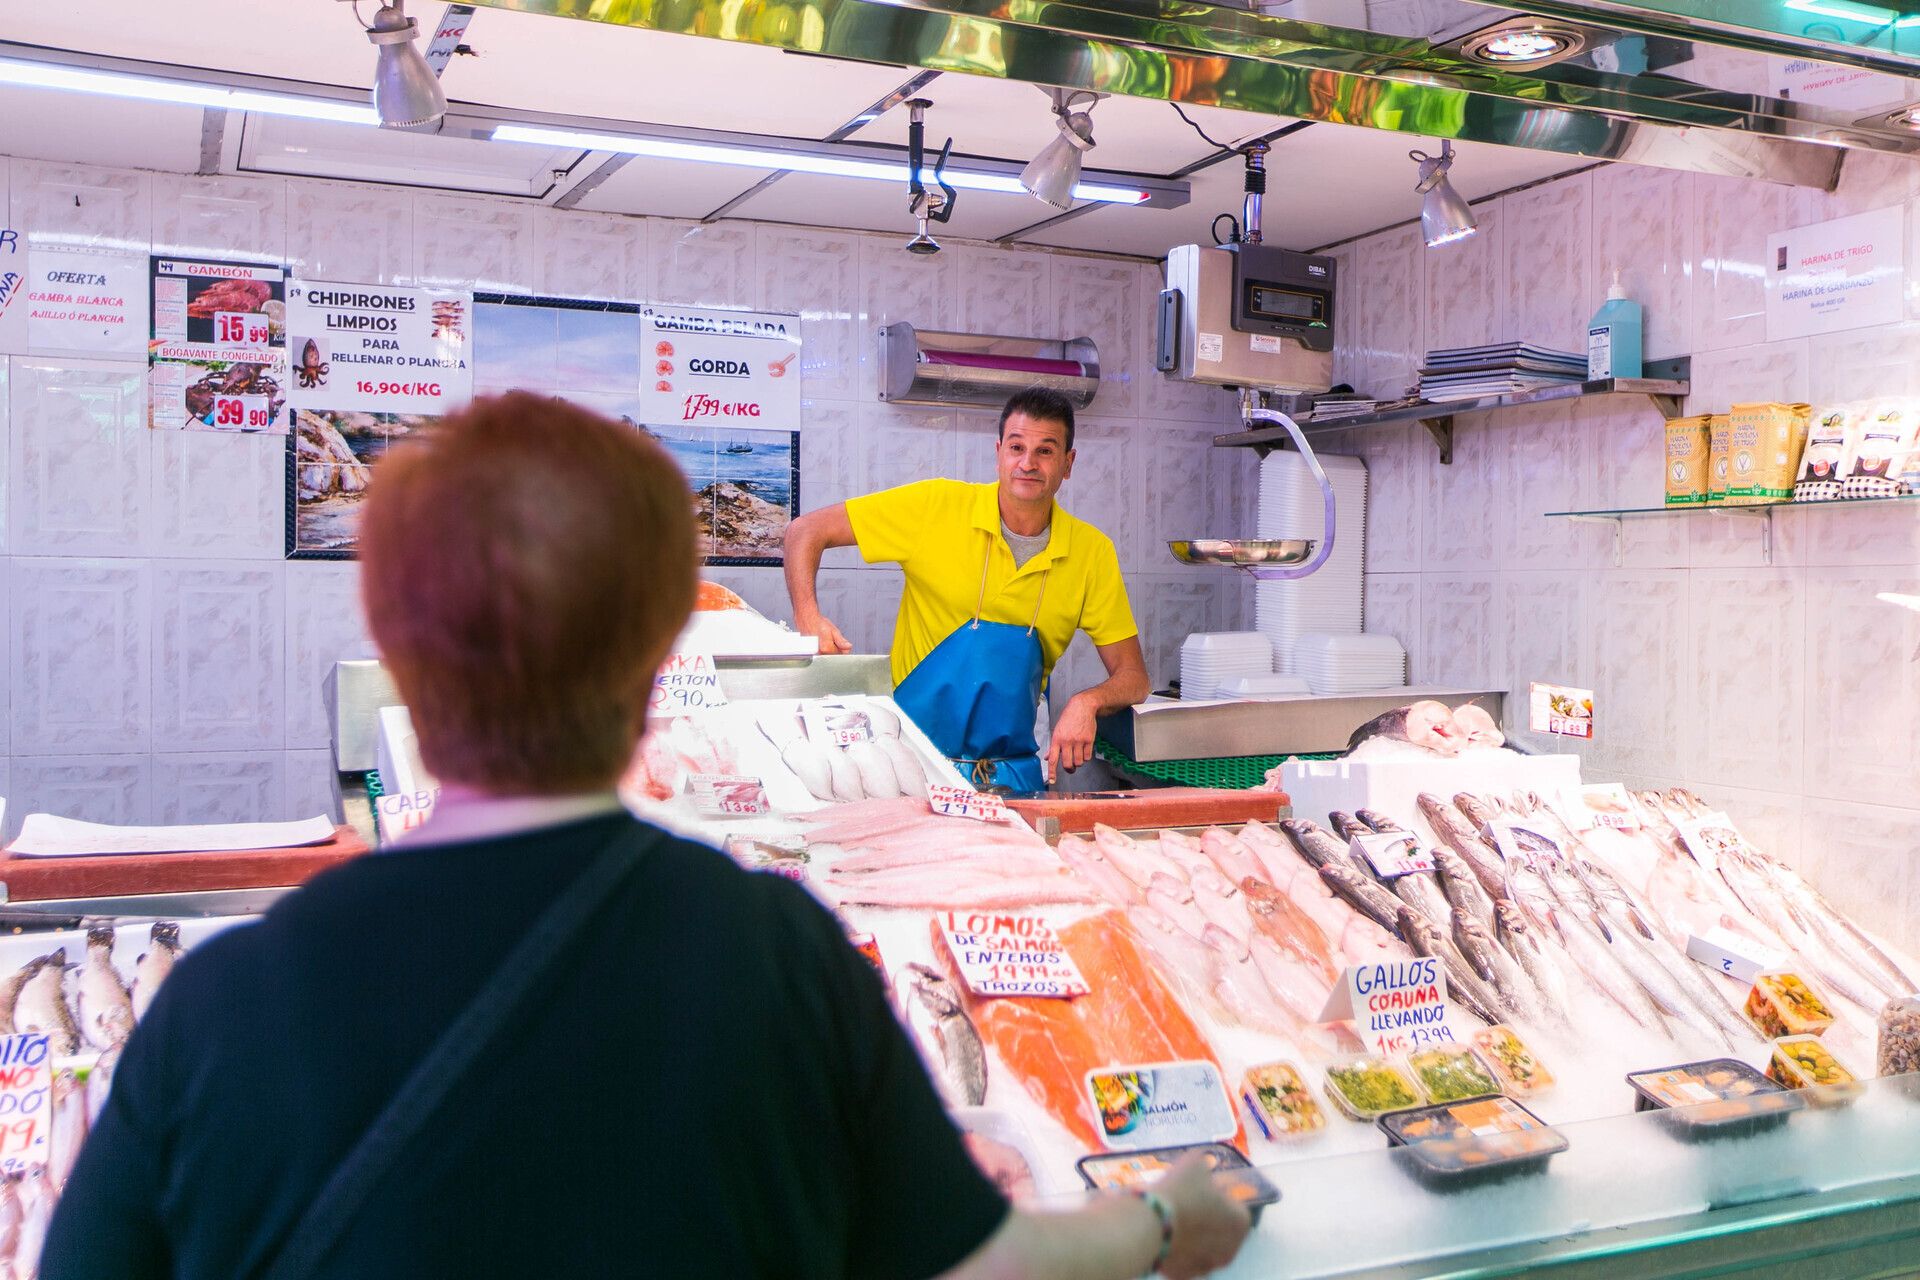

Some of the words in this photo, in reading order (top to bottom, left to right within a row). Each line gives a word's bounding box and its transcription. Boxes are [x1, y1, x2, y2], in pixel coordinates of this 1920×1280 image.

[1801, 255, 1832, 267] HARINA
[1835, 251, 1844, 260] DE
[1847, 244, 1873, 257] TRIGO
[188, 265, 253, 278] GAMBÓN
[1308, 265, 1326, 274] DIBAL
[47, 271, 107, 286] OFERTA
[29, 292, 73, 304] GAMBA
[76, 295, 124, 307] BLANCA
[307, 290, 416, 311] CHIPIRONES
[1782, 288, 1813, 301] HARINA
[30, 310, 66, 320] AJILLO
[78, 313, 125, 324] PLANCHA
[326, 314, 397, 332] LIMPIOS
[362, 339, 399, 350] PARA
[162, 347, 218, 359] BOGAVANTE
[221, 351, 278, 363] CONGELADO
[331, 353, 393, 365] RELLENAR
[396, 356, 406, 366] O
[408, 357, 466, 369] PLANCHA
[689, 358, 750, 375] GORDA
[356, 381, 441, 396] 16,90€/KG
[932, 795, 1005, 808] MERLUZA
[948, 912, 1051, 938] LOMOS
[955, 935, 980, 945] DE
[965, 951, 1060, 964] ENTEROS
[1356, 959, 1436, 994] GALLOS
[975, 980, 1059, 993] TROZOS
[1369, 985, 1439, 1012] CORUÑA
[1371, 1004, 1444, 1030] LLEVANDO
[1140, 1101, 1187, 1115] SALMÓN
